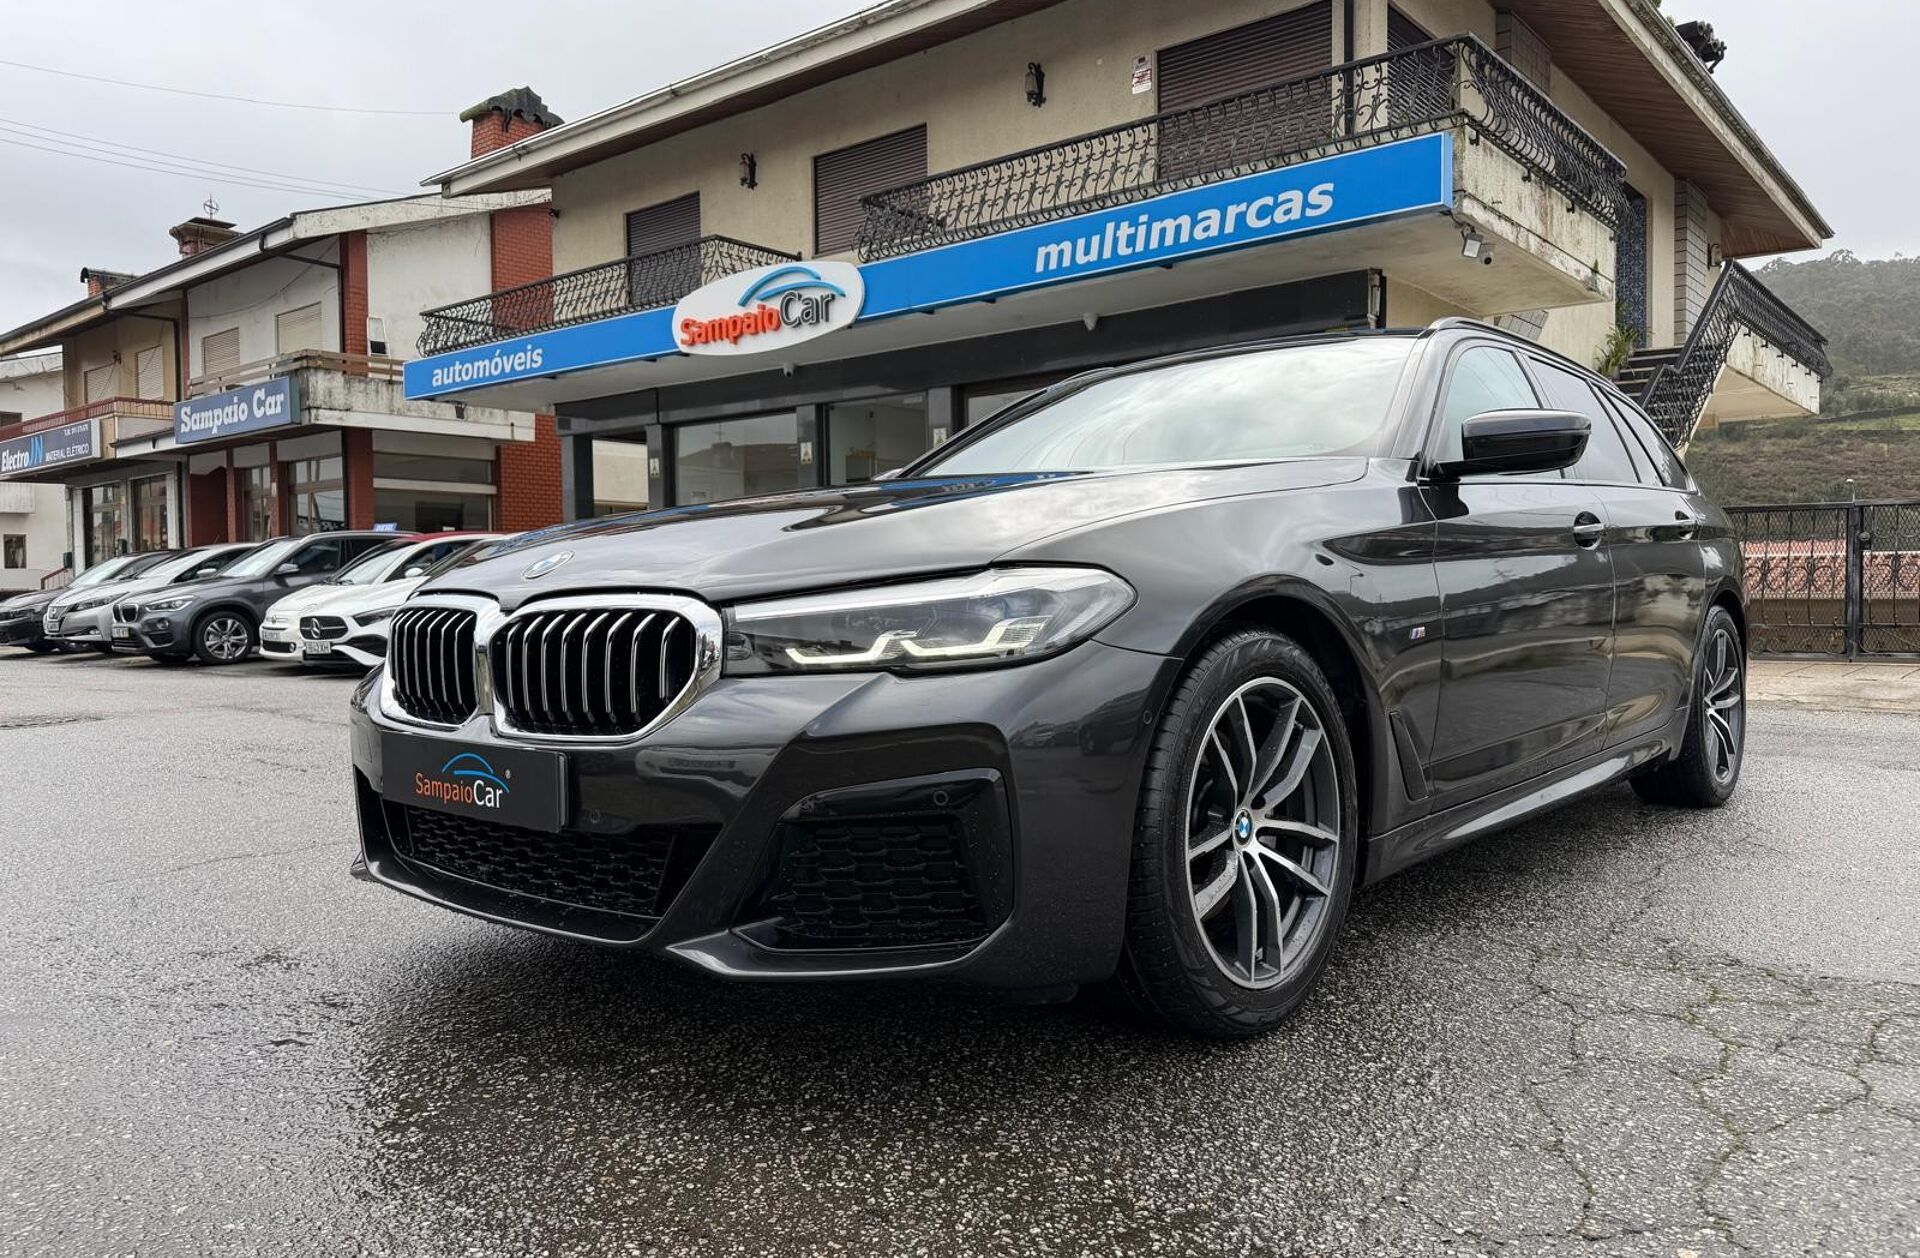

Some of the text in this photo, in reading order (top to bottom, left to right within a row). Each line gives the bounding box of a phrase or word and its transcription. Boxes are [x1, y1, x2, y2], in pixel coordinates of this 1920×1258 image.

[1034, 182, 1335, 273] multimarcas
[680, 289, 836, 346] SampaioCar
[431, 347, 543, 388] automóveis
[180, 388, 285, 434] Sampaio Car
[415, 772, 503, 809] SampaioCar
